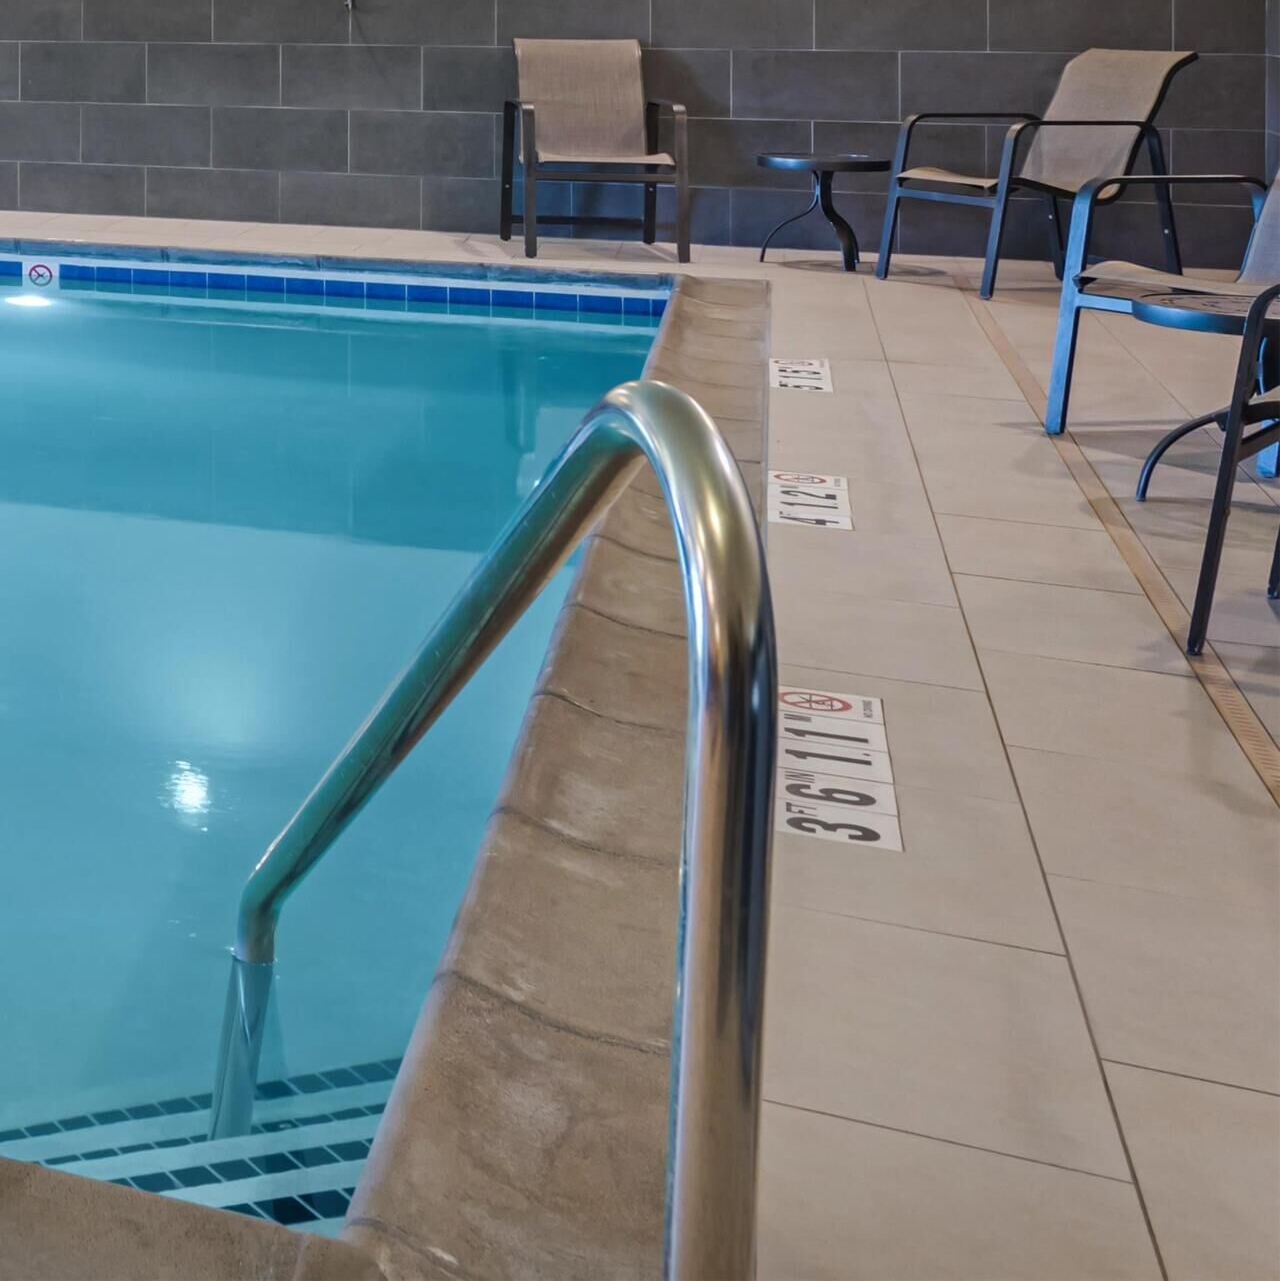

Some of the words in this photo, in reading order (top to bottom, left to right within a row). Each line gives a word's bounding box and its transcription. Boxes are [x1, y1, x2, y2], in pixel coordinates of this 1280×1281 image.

[779, 515, 841, 527] 4
[784, 782, 878, 807] 6
[785, 815, 882, 843] 3
